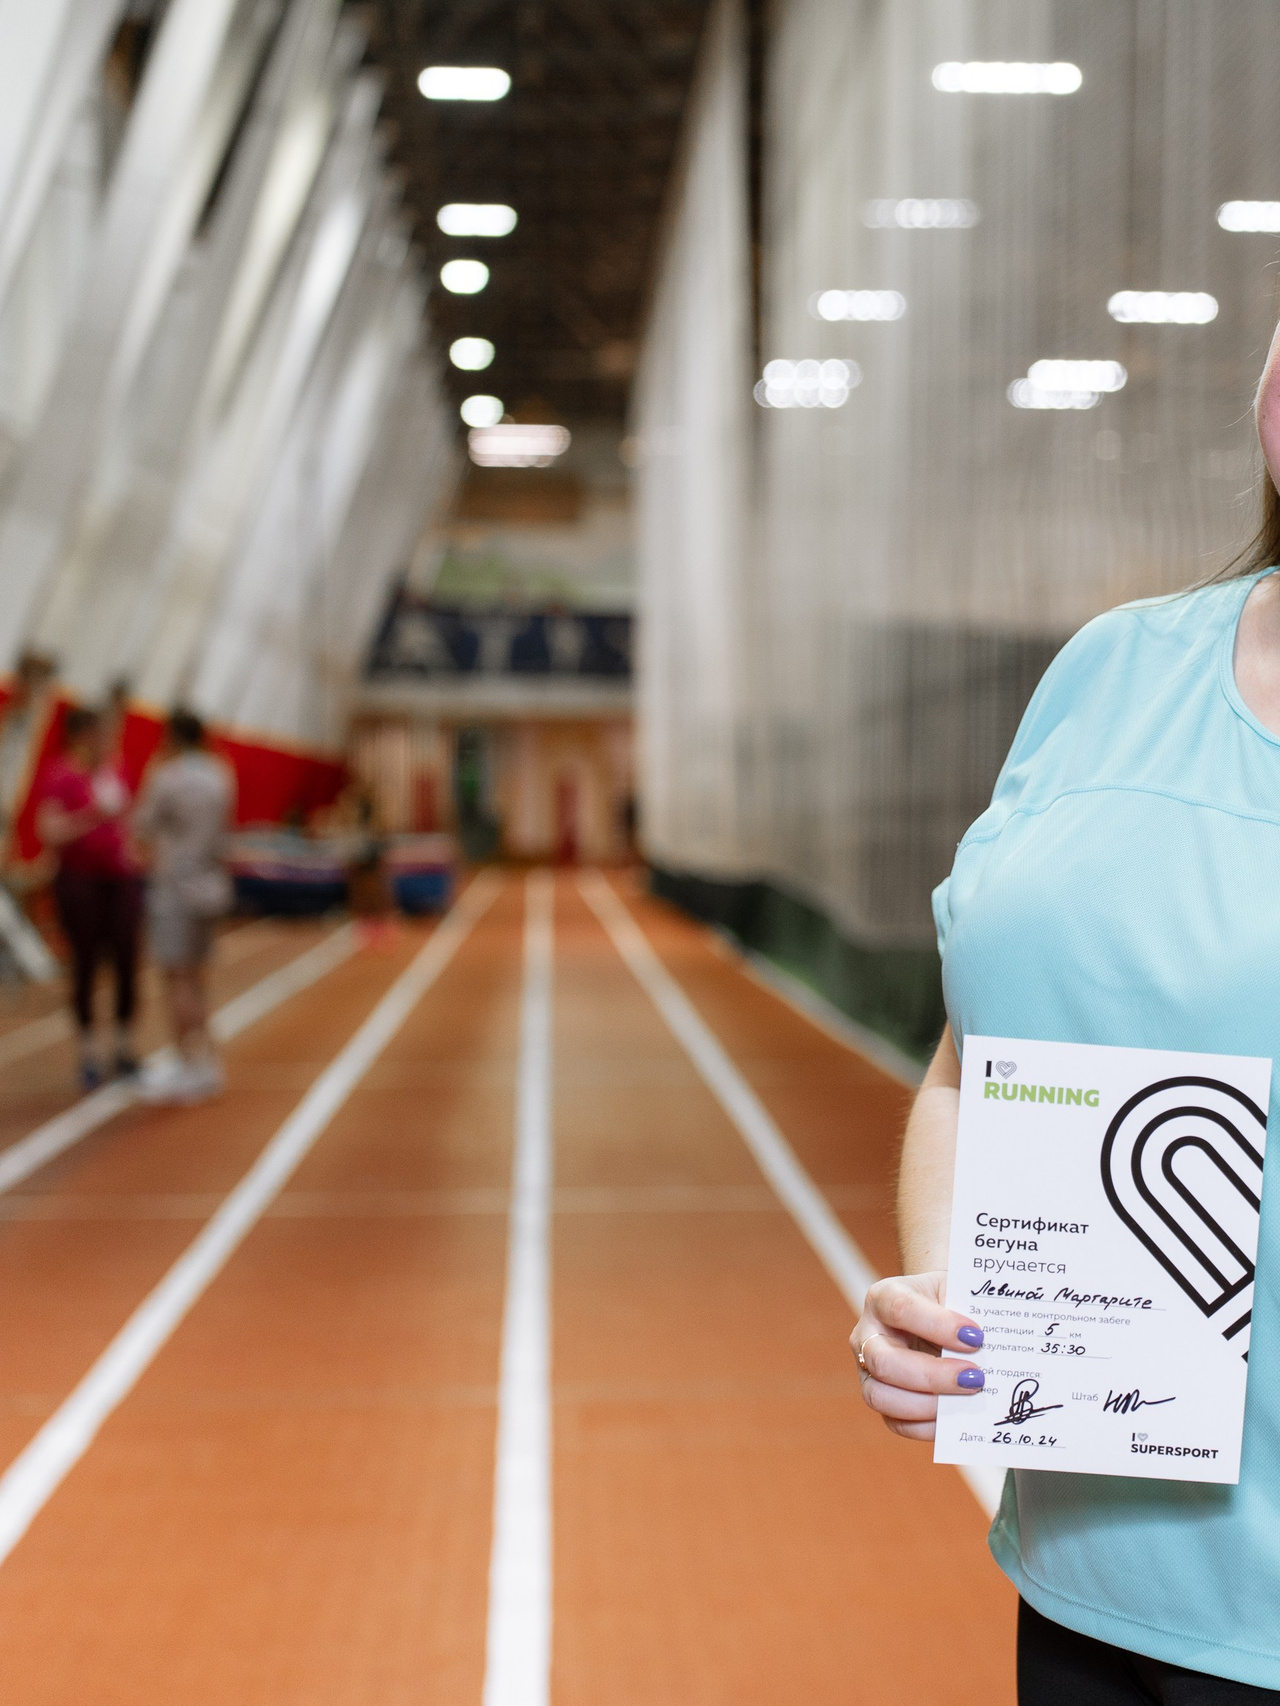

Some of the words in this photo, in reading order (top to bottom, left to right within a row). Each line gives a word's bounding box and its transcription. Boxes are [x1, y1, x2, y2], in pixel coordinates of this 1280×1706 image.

[985, 1060, 992, 1078] I
[983, 1081, 1100, 1108] RUNNING
[976, 1212, 1089, 1235] Сертификат
[974, 1233, 1039, 1254] бегуна
[973, 1257, 1067, 1275] вручается
[970, 1279, 1045, 1301] Левиной
[1053, 1287, 1153, 1311] Маргарите
[969, 1306, 981, 1315] За
[983, 1308, 1022, 1319] участие
[1031, 1312, 1097, 1325] контрольном
[1098, 1317, 1131, 1326] забеге
[982, 1325, 1034, 1336] дистанции
[1044, 1323, 1060, 1336] 5
[980, 1342, 1034, 1353] езультатом
[1040, 1342, 1086, 1356] 35:30
[1071, 1391, 1099, 1402] Штаб
[959, 1432, 986, 1443] Дата:
[1131, 1432, 1136, 1442] I
[1130, 1443, 1219, 1459] SUPERSPORT
